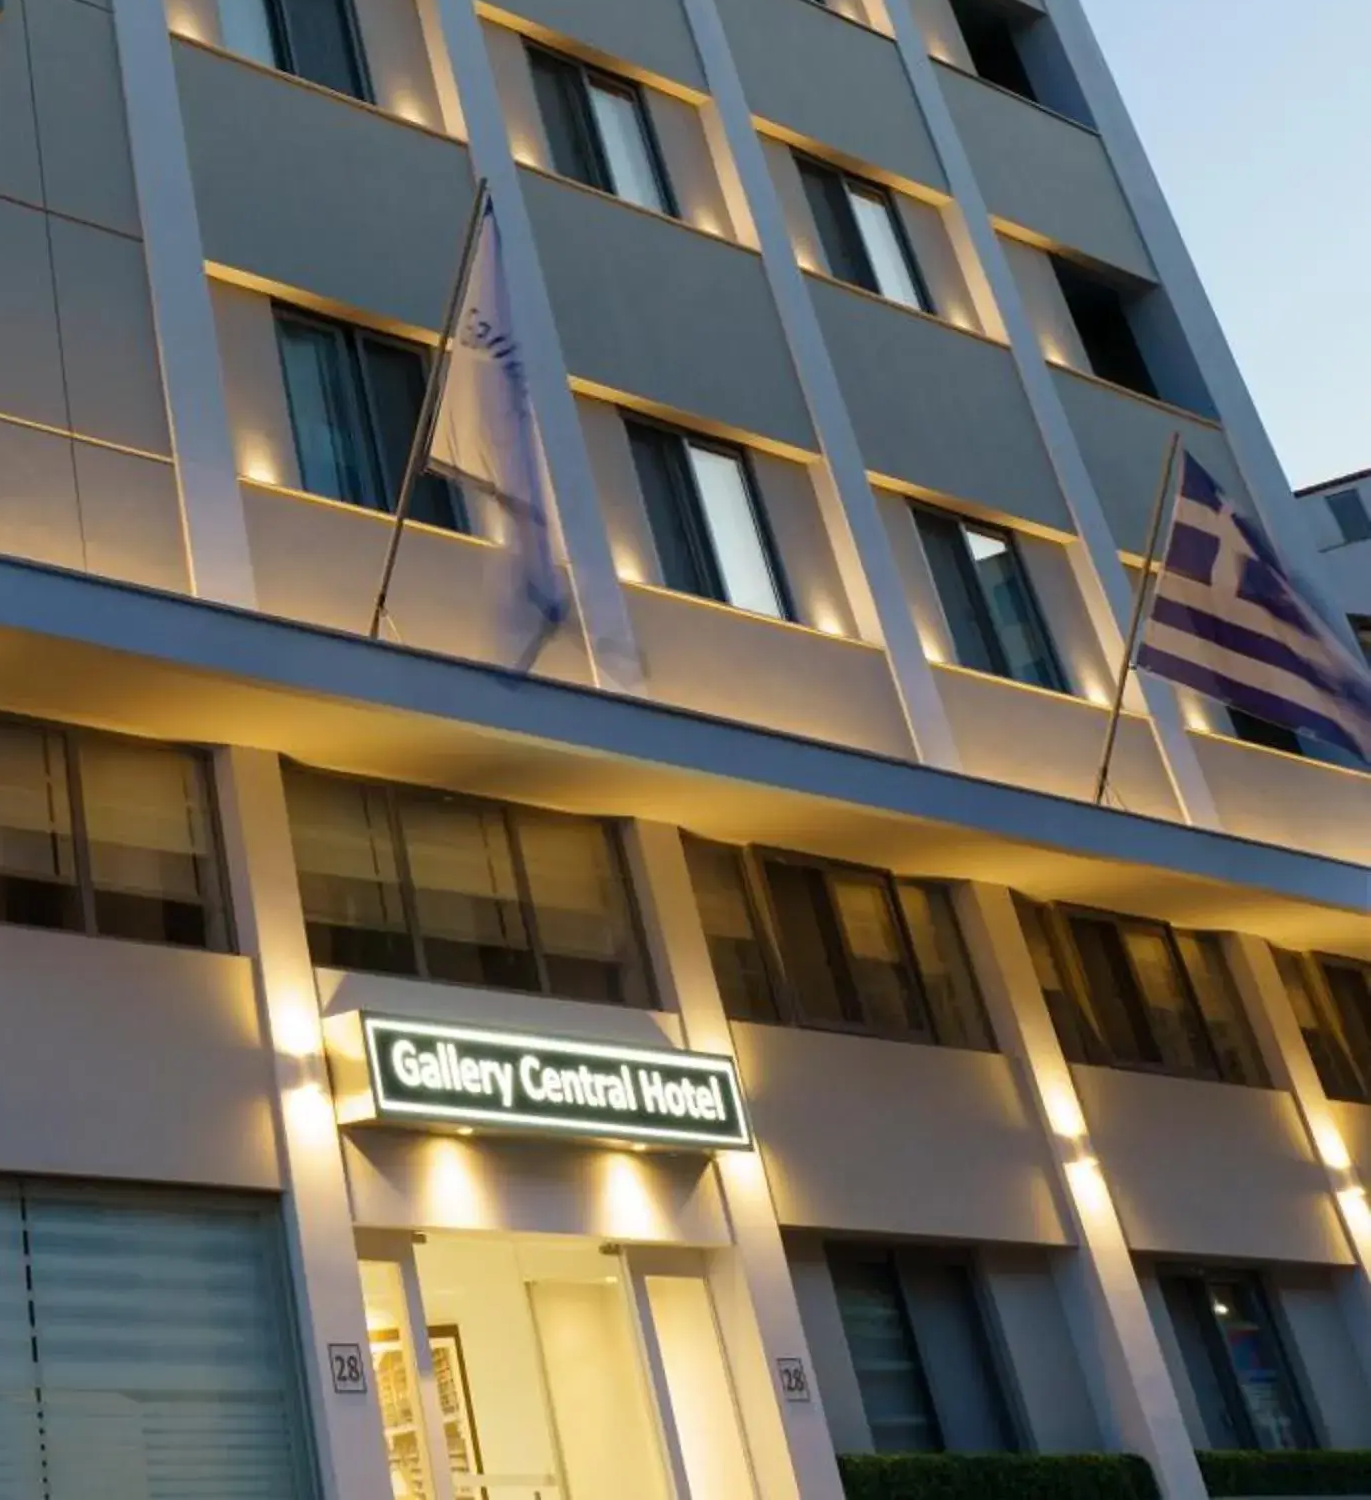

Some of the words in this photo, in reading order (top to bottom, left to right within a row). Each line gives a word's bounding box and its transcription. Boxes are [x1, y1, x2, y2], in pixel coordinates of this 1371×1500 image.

[392, 1039, 513, 1107] Gallery
[520, 1055, 636, 1112] Central
[640, 1069, 726, 1121] Hotel
[335, 1356, 360, 1383] 28
[783, 1369, 804, 1392] 28
